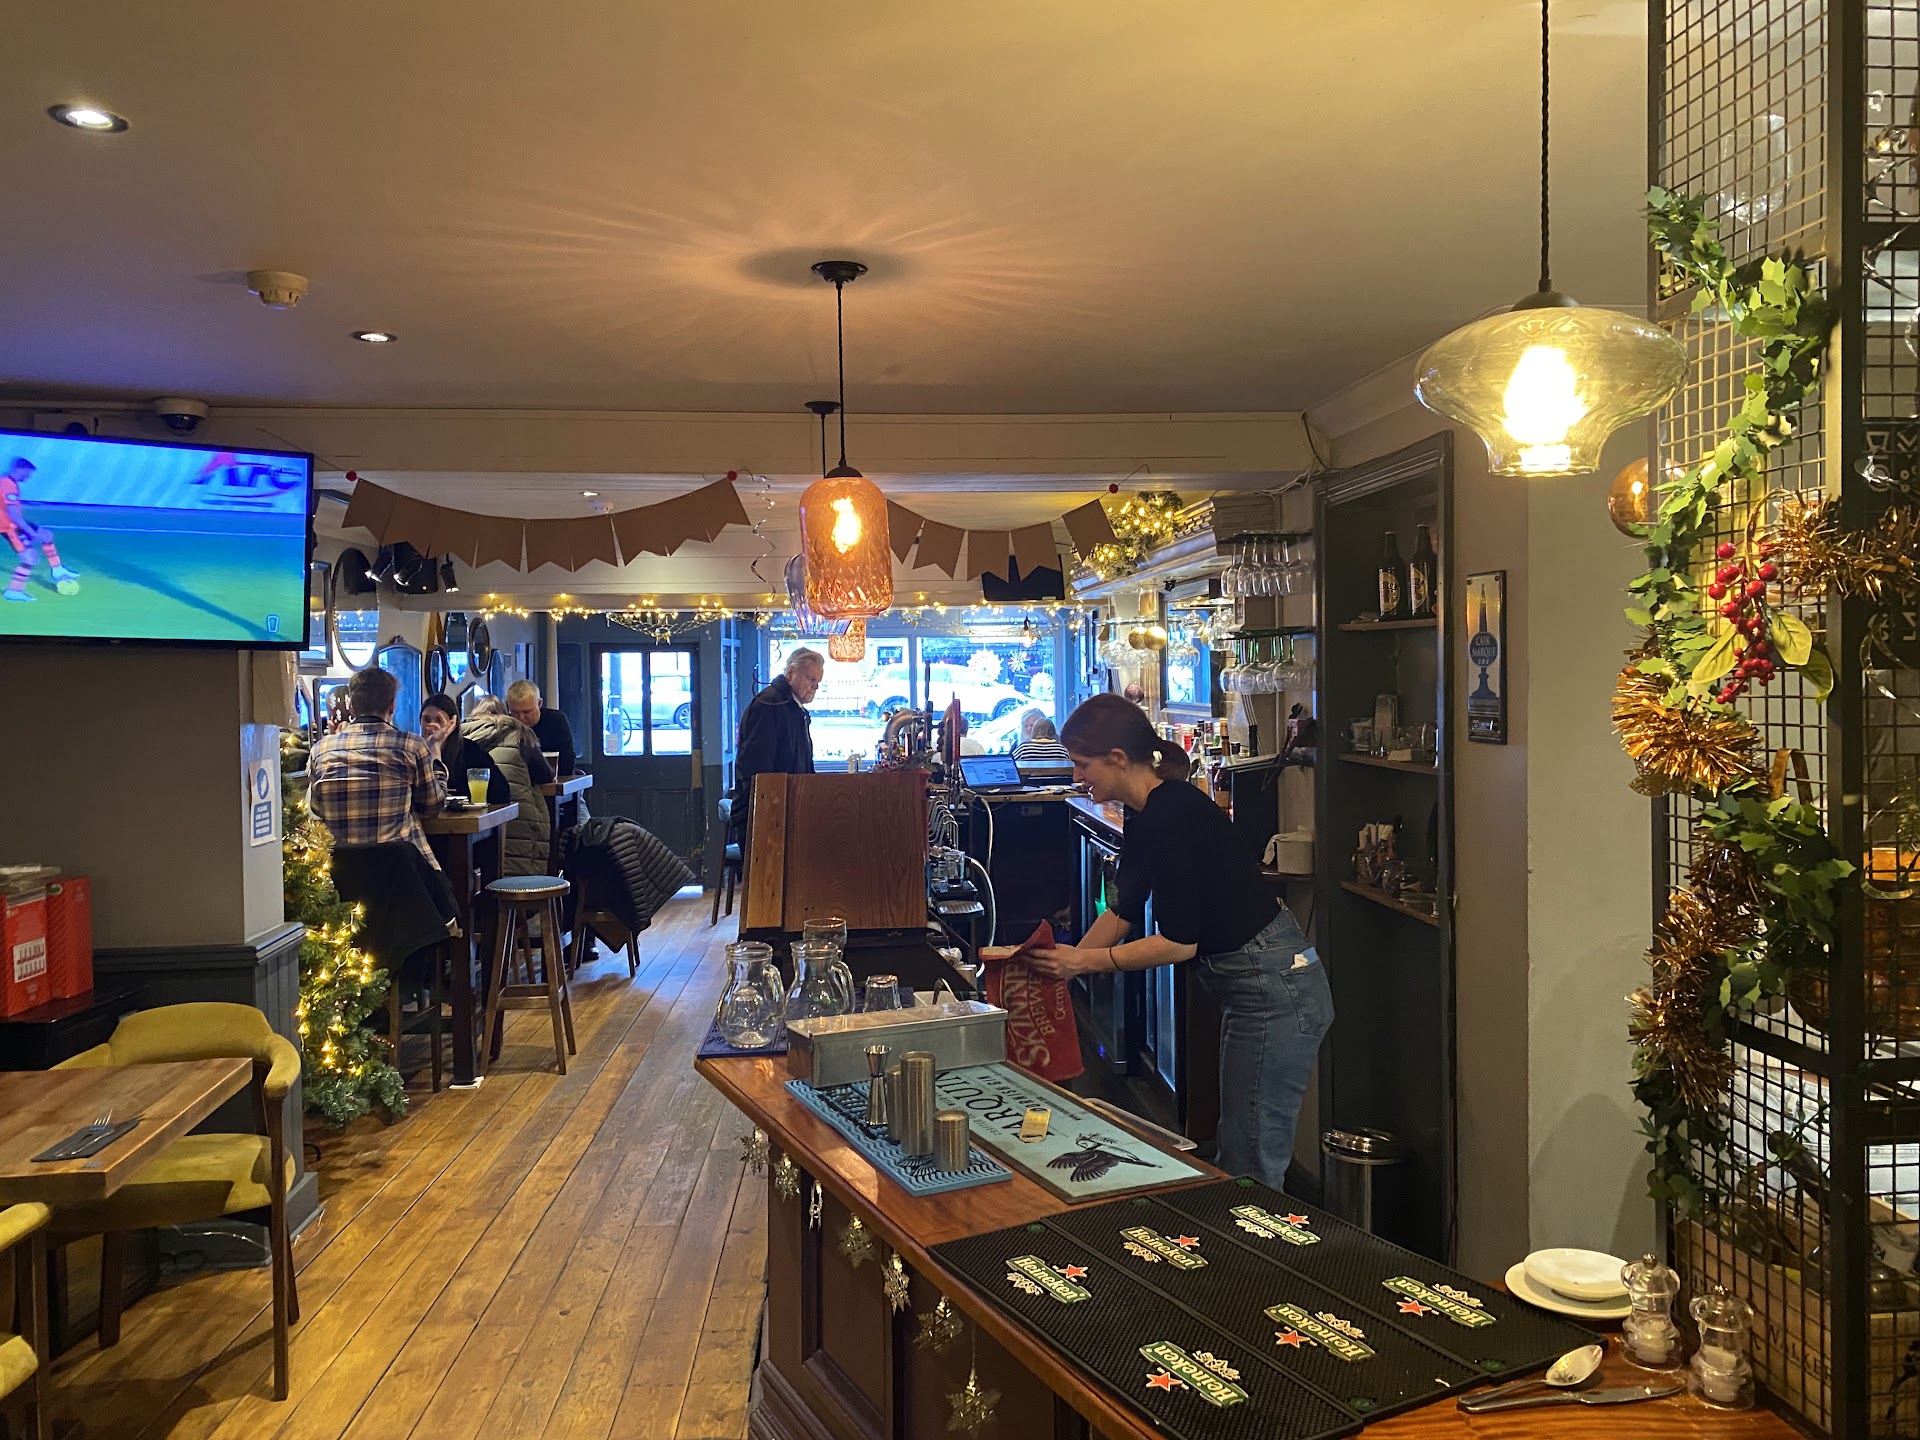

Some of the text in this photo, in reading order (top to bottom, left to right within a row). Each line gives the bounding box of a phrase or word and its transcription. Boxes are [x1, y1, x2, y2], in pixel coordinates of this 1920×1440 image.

[1475, 635, 1491, 646] CASK
[1003, 963, 1051, 1068] SKINNE
[1027, 975, 1056, 1037] BREWE
[1238, 1205, 1308, 1243] Heineken
[1129, 1227, 1196, 1268] Heineken
[1013, 1256, 1078, 1301] Heineken
[1397, 1279, 1488, 1324] Heineken
[1276, 1306, 1366, 1358] Heineken
[1152, 1343, 1239, 1403] Heineken
